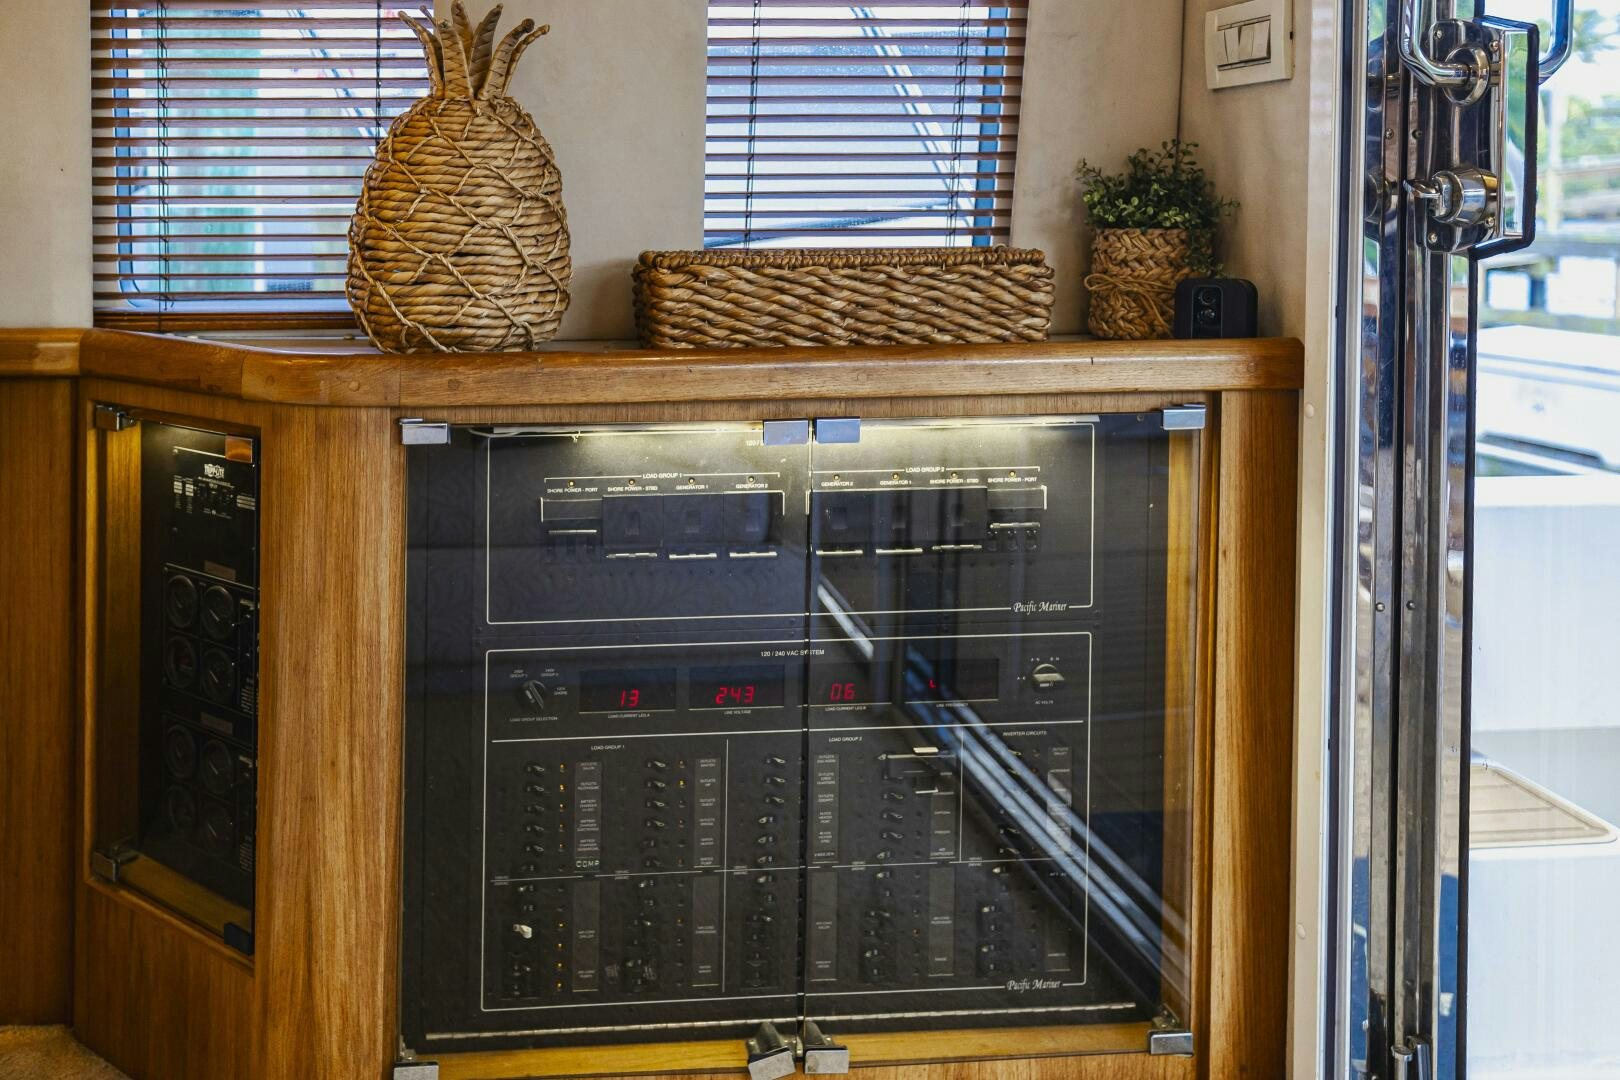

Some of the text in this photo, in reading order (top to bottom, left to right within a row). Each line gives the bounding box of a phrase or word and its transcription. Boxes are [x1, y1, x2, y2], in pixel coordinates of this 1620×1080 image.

[1013, 601, 1067, 614] Pacific Mariner
[620, 689, 640, 708] 13
[715, 685, 756, 705] 243
[830, 683, 855, 701] 06
[1007, 978, 1061, 994] Pacific Mariner
